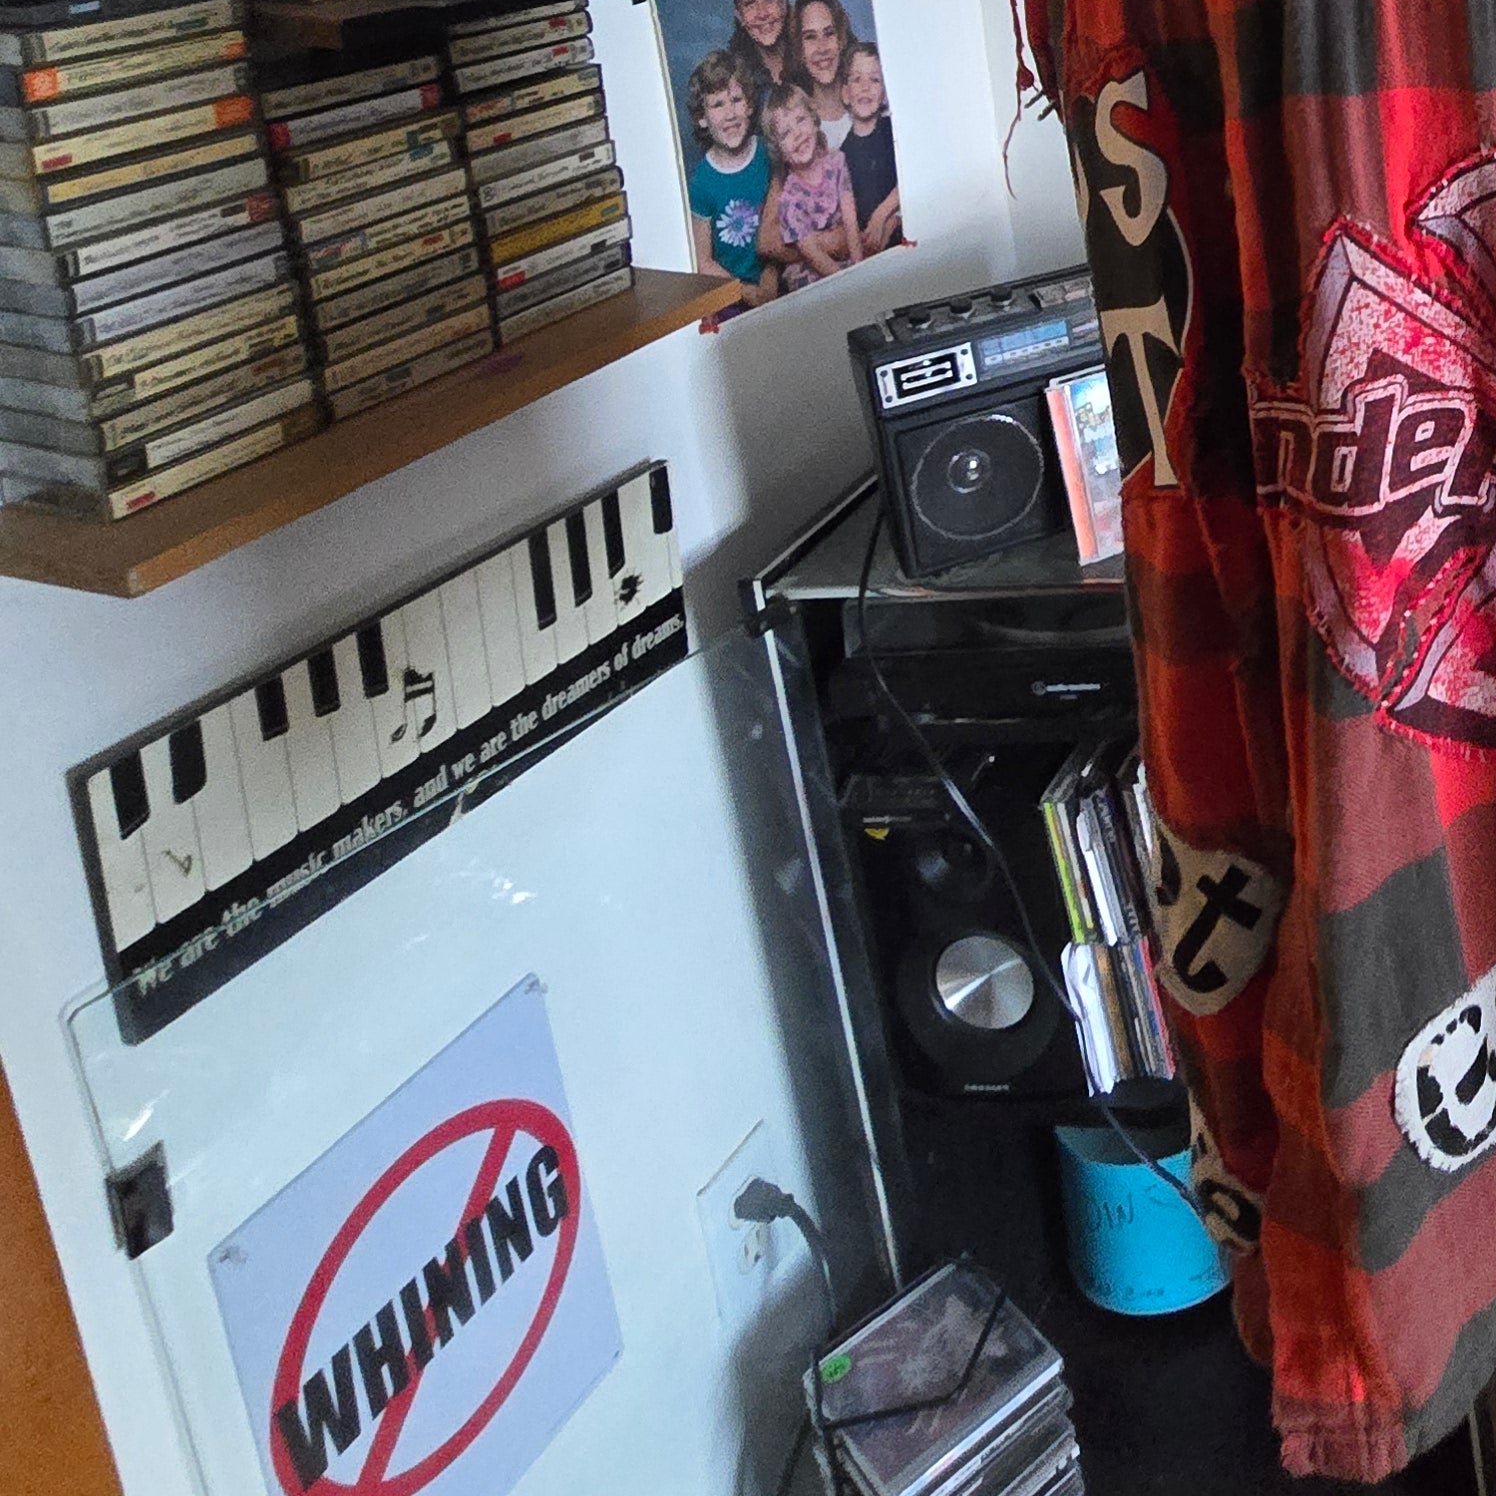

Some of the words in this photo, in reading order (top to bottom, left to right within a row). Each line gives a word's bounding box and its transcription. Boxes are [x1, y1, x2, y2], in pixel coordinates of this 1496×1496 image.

[413, 764, 450, 808] and
[450, 751, 478, 781] we
[479, 729, 508, 763] are
[509, 710, 540, 742] the
[541, 660, 612, 722] dreamers
[613, 642, 629, 672] of
[273, 1144, 570, 1493] WHINING
